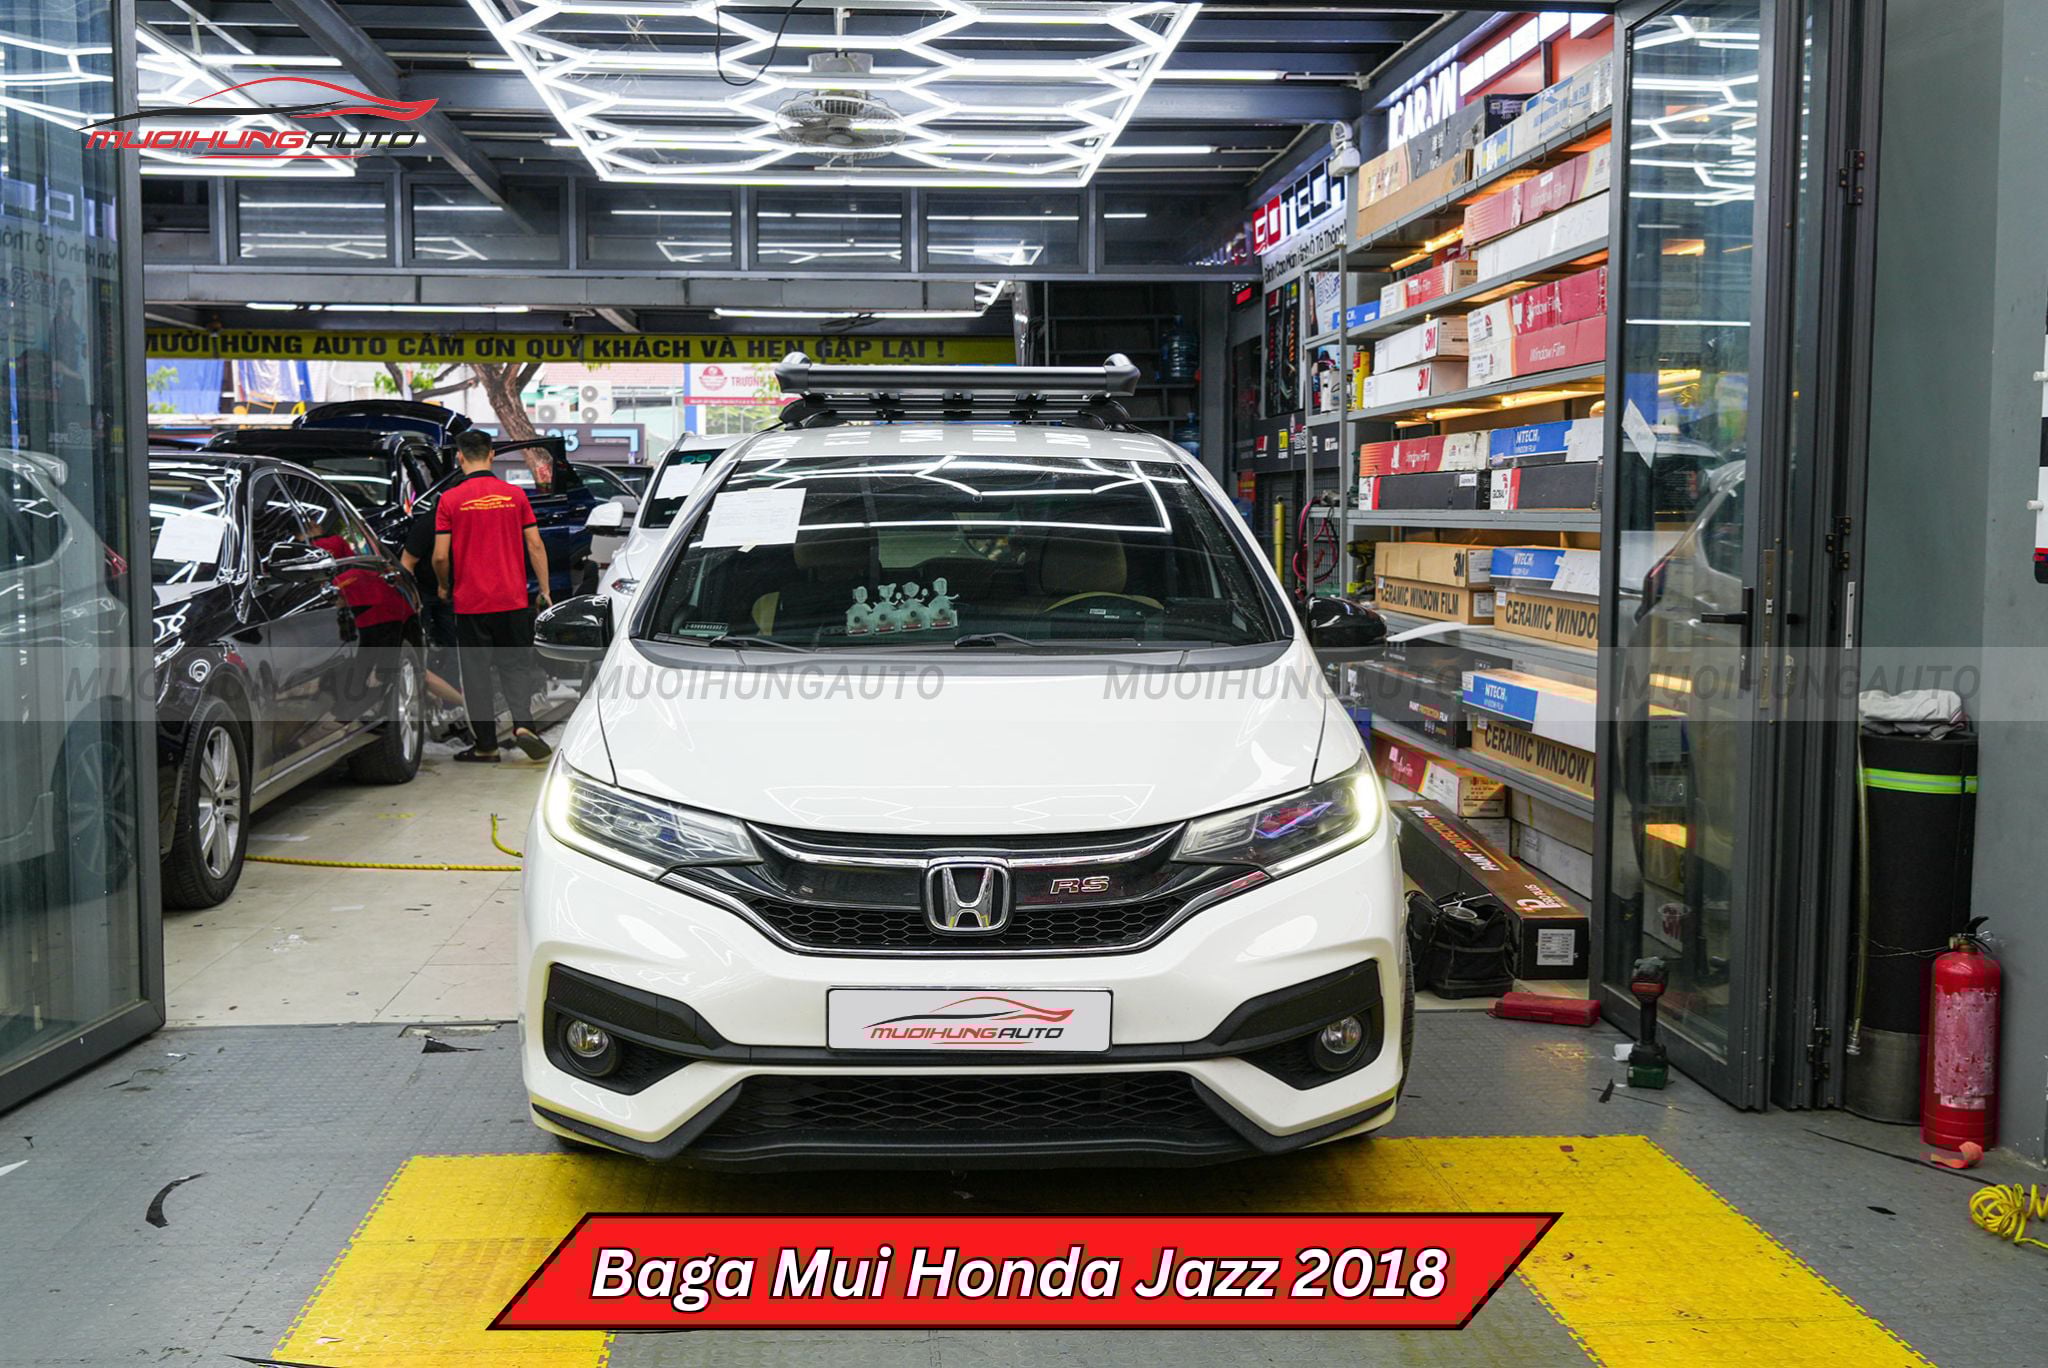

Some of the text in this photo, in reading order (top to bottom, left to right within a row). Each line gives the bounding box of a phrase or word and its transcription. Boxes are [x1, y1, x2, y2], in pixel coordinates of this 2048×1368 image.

[221, 331, 303, 355] HÙNG
[312, 336, 387, 357] AUTO
[398, 333, 465, 358] CẢM
[475, 336, 516, 358] ƠN
[526, 335, 582, 360] QUÝ
[592, 336, 691, 359] KHÁCH
[700, 336, 738, 359] VÀ
[881, 338, 928, 365] LẠI
[936, 339, 946, 359] !
[1425, 326, 1437, 353] 3M
[1418, 367, 1431, 391] 3M
[1516, 429, 1540, 444] NTECH
[1453, 552, 1465, 578] 3M
[1513, 552, 1535, 566] NTECH
[1409, 587, 1440, 613] WINDOW
[1440, 591, 1459, 616] FILM
[1505, 599, 1554, 631] CERAMIC
[1554, 607, 1600, 640] WINDO
[1485, 683, 1506, 701] NTECH
[1485, 724, 1534, 763] CERAMIC
[1535, 740, 1590, 785] WINDOW
[1050, 876, 1110, 895] RS
